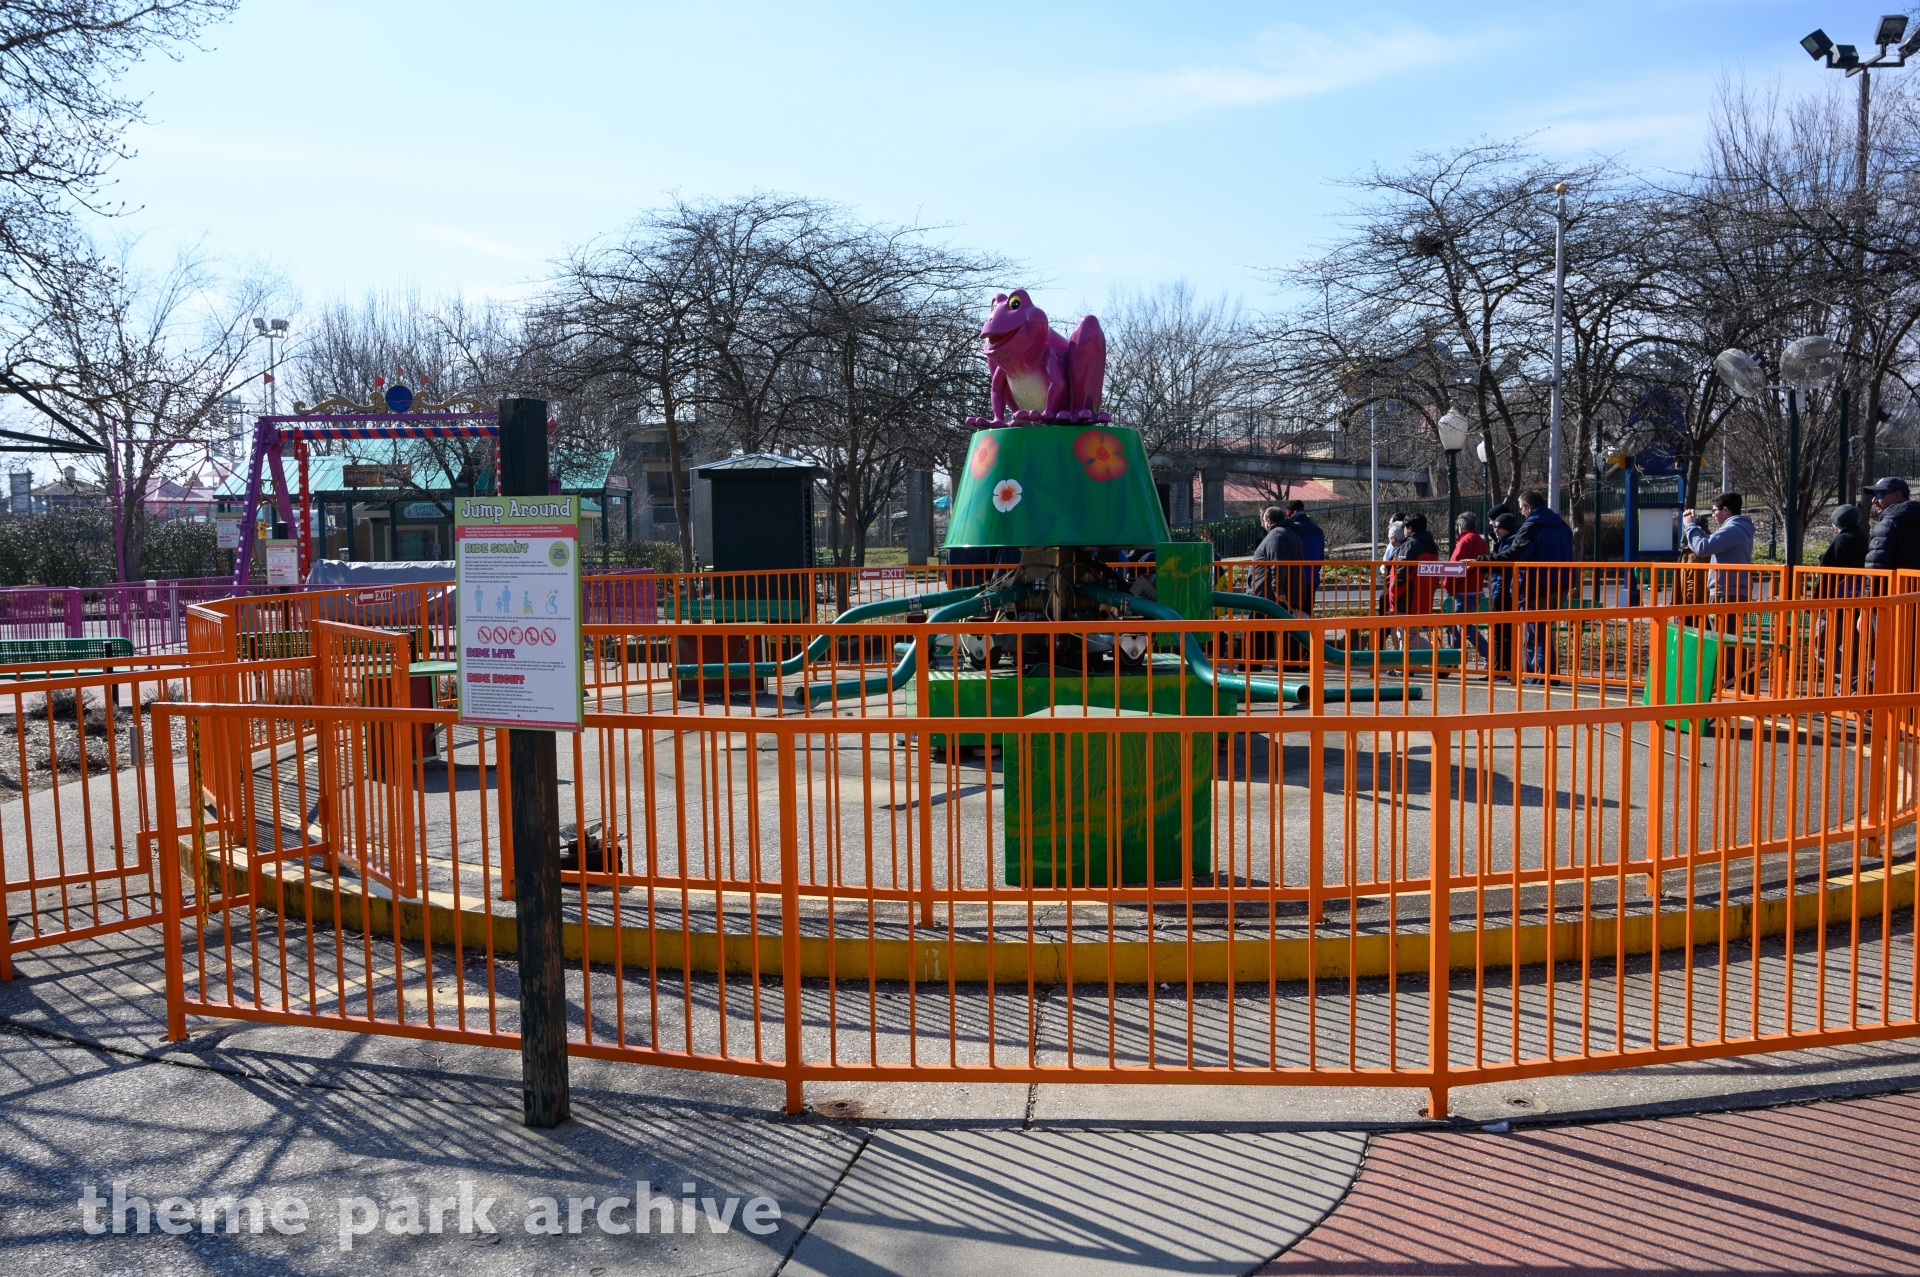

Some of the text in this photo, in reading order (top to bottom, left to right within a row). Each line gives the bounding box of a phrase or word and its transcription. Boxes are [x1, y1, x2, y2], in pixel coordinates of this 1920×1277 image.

[461, 500, 504, 523] Jump
[508, 498, 571, 517] Around
[465, 543, 529, 553] RIDE SMART
[881, 569, 903, 578] EXIT
[1420, 564, 1443, 573] EXIT
[375, 589, 392, 601] EXIT
[466, 647, 515, 658] RIDE LITE
[467, 673, 525, 684] RIDE RIGHT
